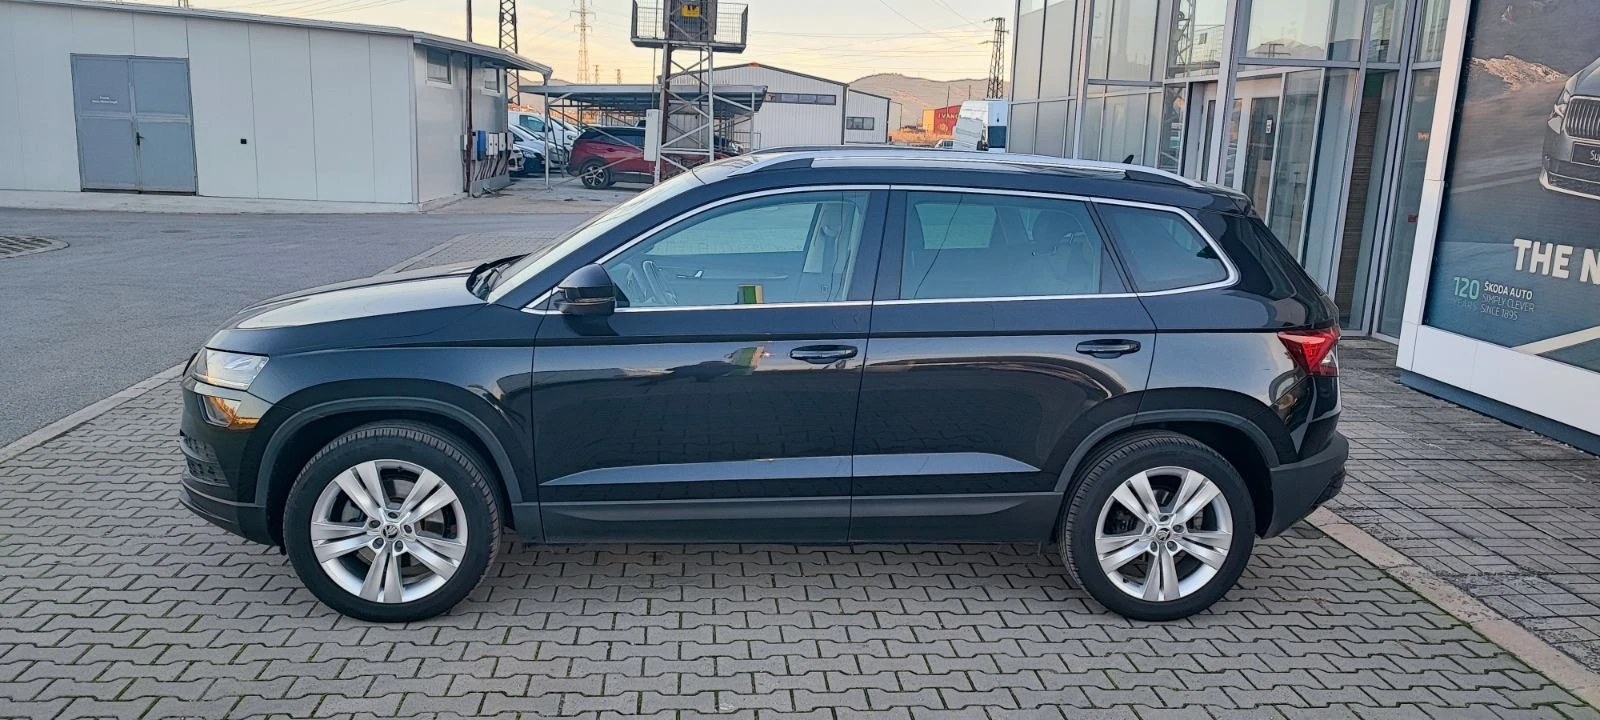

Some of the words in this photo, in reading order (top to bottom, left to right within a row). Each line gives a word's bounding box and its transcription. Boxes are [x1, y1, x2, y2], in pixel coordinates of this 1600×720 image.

[1513, 238, 1574, 279] THE
[1453, 276, 1480, 300] 120
[1483, 281, 1509, 296] ŠKODA
[1509, 287, 1533, 300] AUTO
[1480, 303, 1501, 317] SINCE
[1501, 308, 1519, 321] 1895
[1482, 294, 1507, 306] SIMPLY
[1506, 298, 1535, 313] CLEVER
